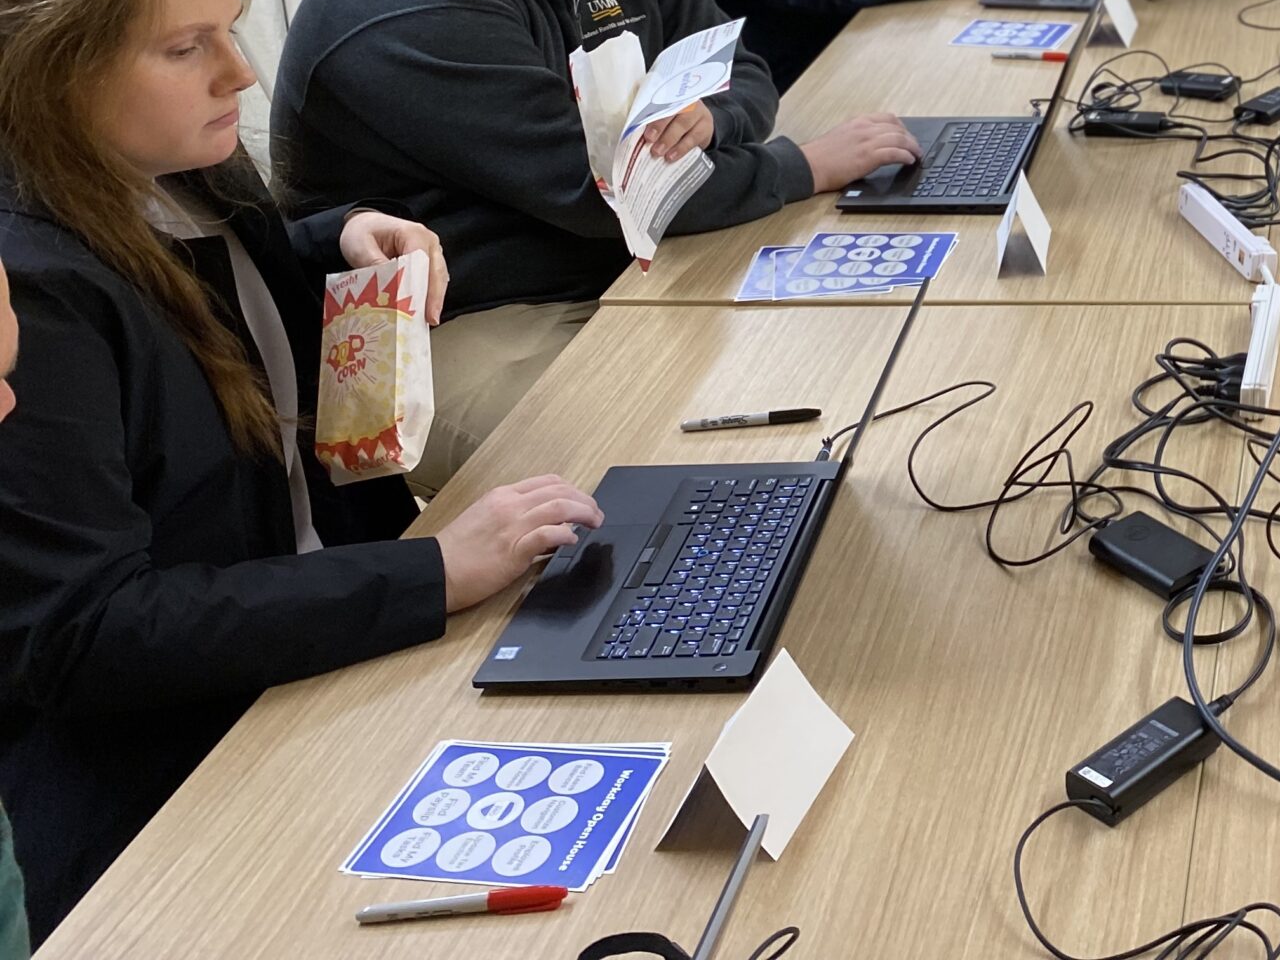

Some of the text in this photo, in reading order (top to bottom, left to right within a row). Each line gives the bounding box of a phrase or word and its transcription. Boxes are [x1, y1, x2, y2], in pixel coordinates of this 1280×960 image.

[326, 335, 364, 371] POP
[337, 357, 367, 384] CORN
[455, 760, 474, 777] Team
[460, 755, 490, 783] Find My
[420, 792, 449, 820] Payslip
[438, 798, 458, 815] Find
[558, 770, 633, 870] Workday Open House
[393, 836, 416, 857] Tasks
[398, 832, 431, 863] Find My
